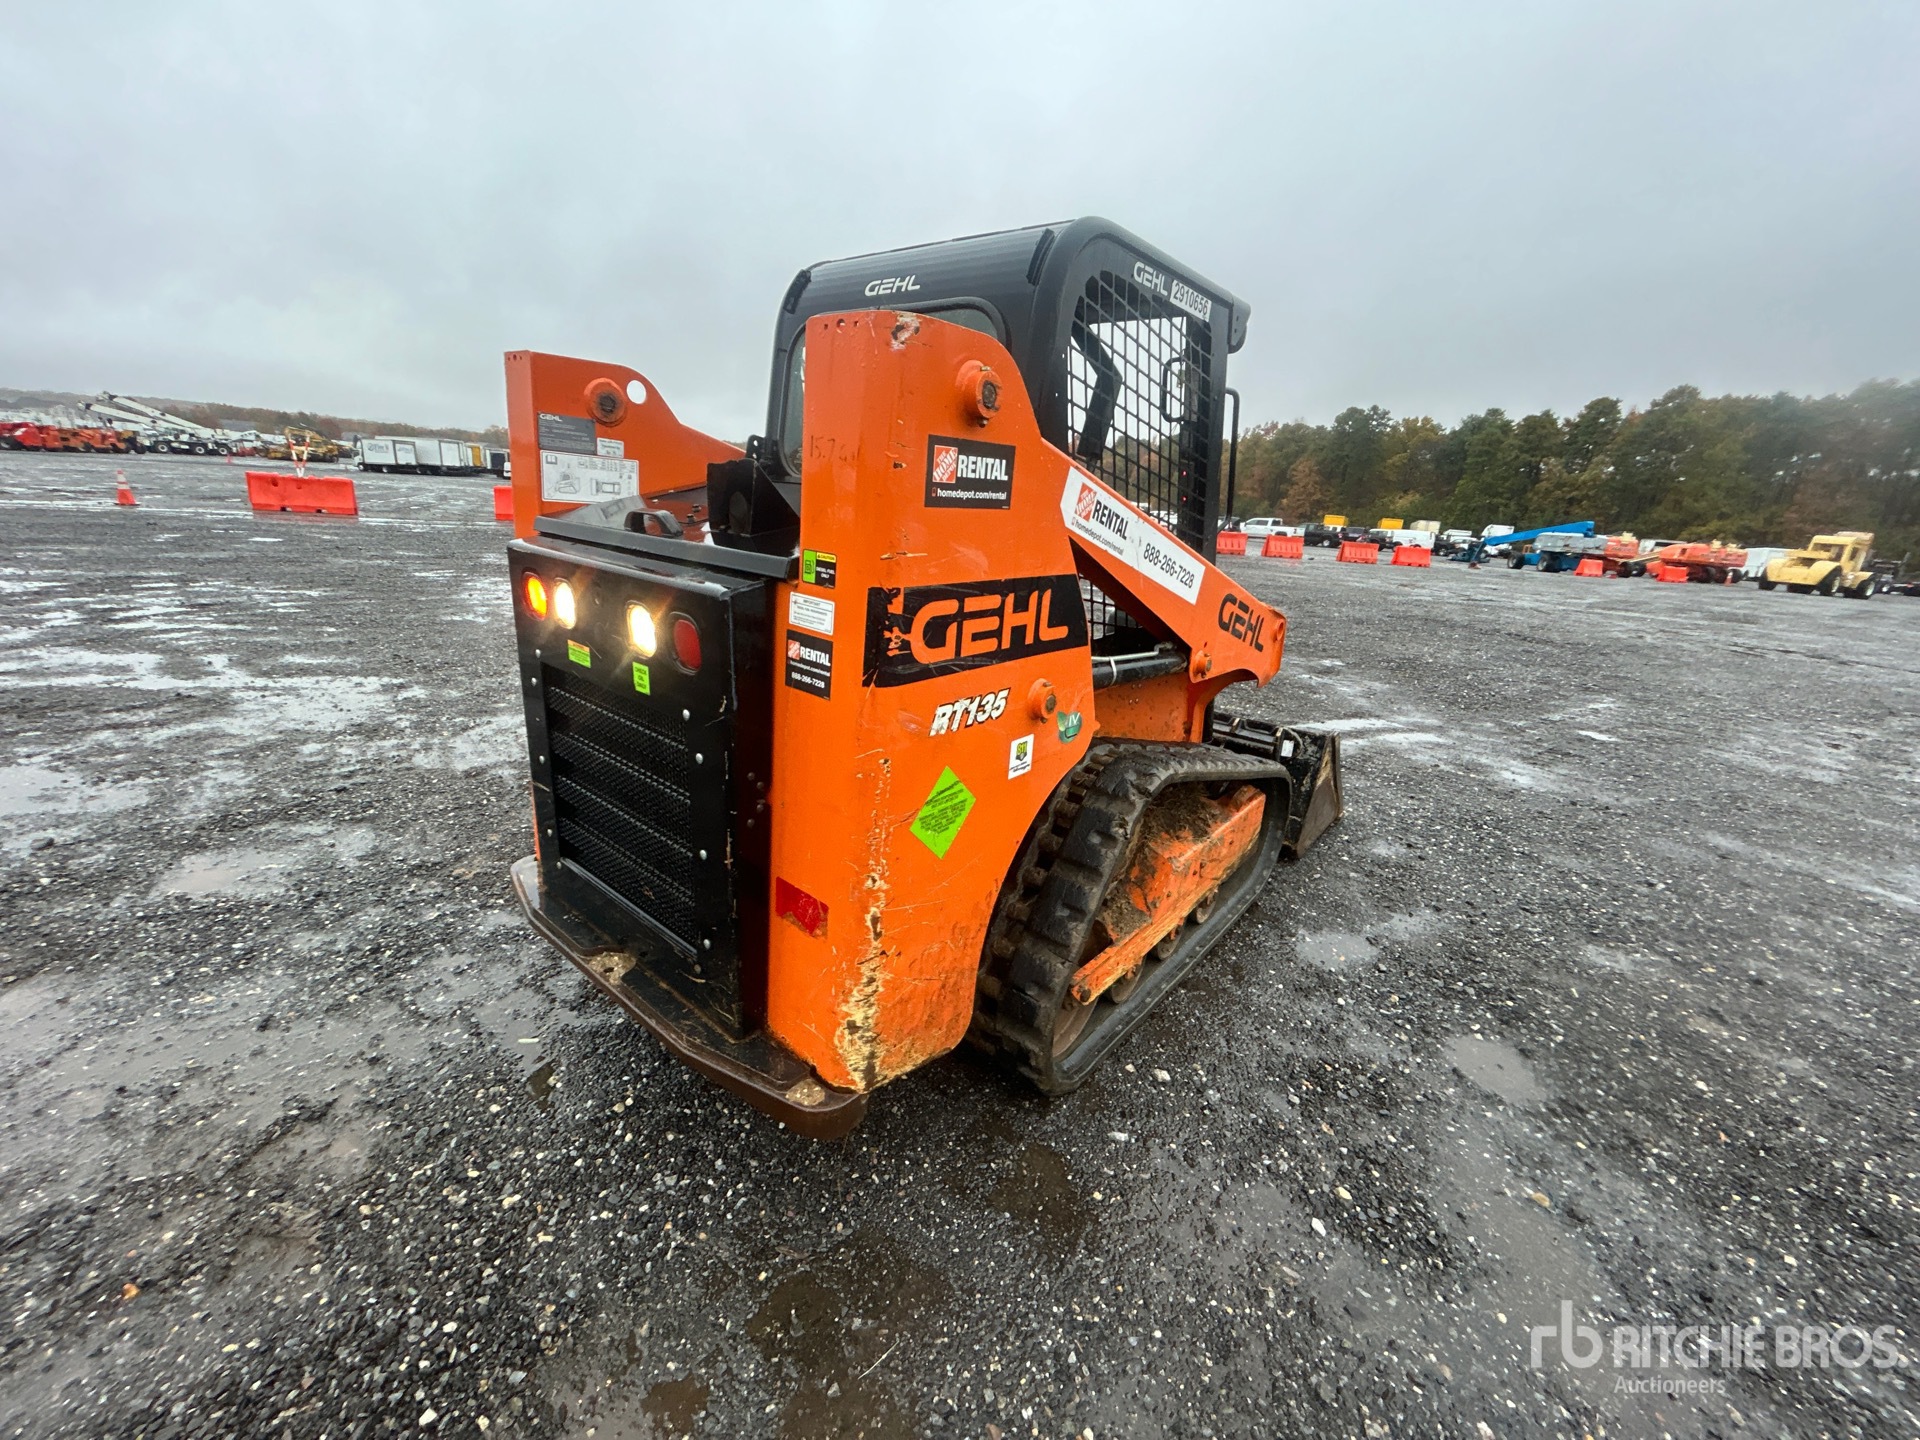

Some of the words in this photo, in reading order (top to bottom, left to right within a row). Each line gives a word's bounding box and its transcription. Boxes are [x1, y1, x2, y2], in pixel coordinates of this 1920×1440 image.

[864, 274, 921, 297] GEHL
[1133, 261, 1168, 296] GEHL
[1173, 283, 1209, 316] 2910656
[539, 413, 562, 422] GEHL
[933, 447, 958, 481] HOME
[957, 454, 1009, 481] RENTAL
[937, 487, 1007, 500] homedepot.com/rental
[1092, 500, 1128, 540] RENTAL
[1075, 519, 1124, 556] homedepot.com/rental
[1143, 542, 1195, 589] 888-266-7228
[909, 588, 1069, 665] GEHL
[1218, 593, 1264, 652] GEHL
[800, 646, 831, 667] RENTAL
[929, 687, 1011, 737] RT135
[1068, 712, 1081, 727] IV
[1016, 740, 1028, 756] 811
